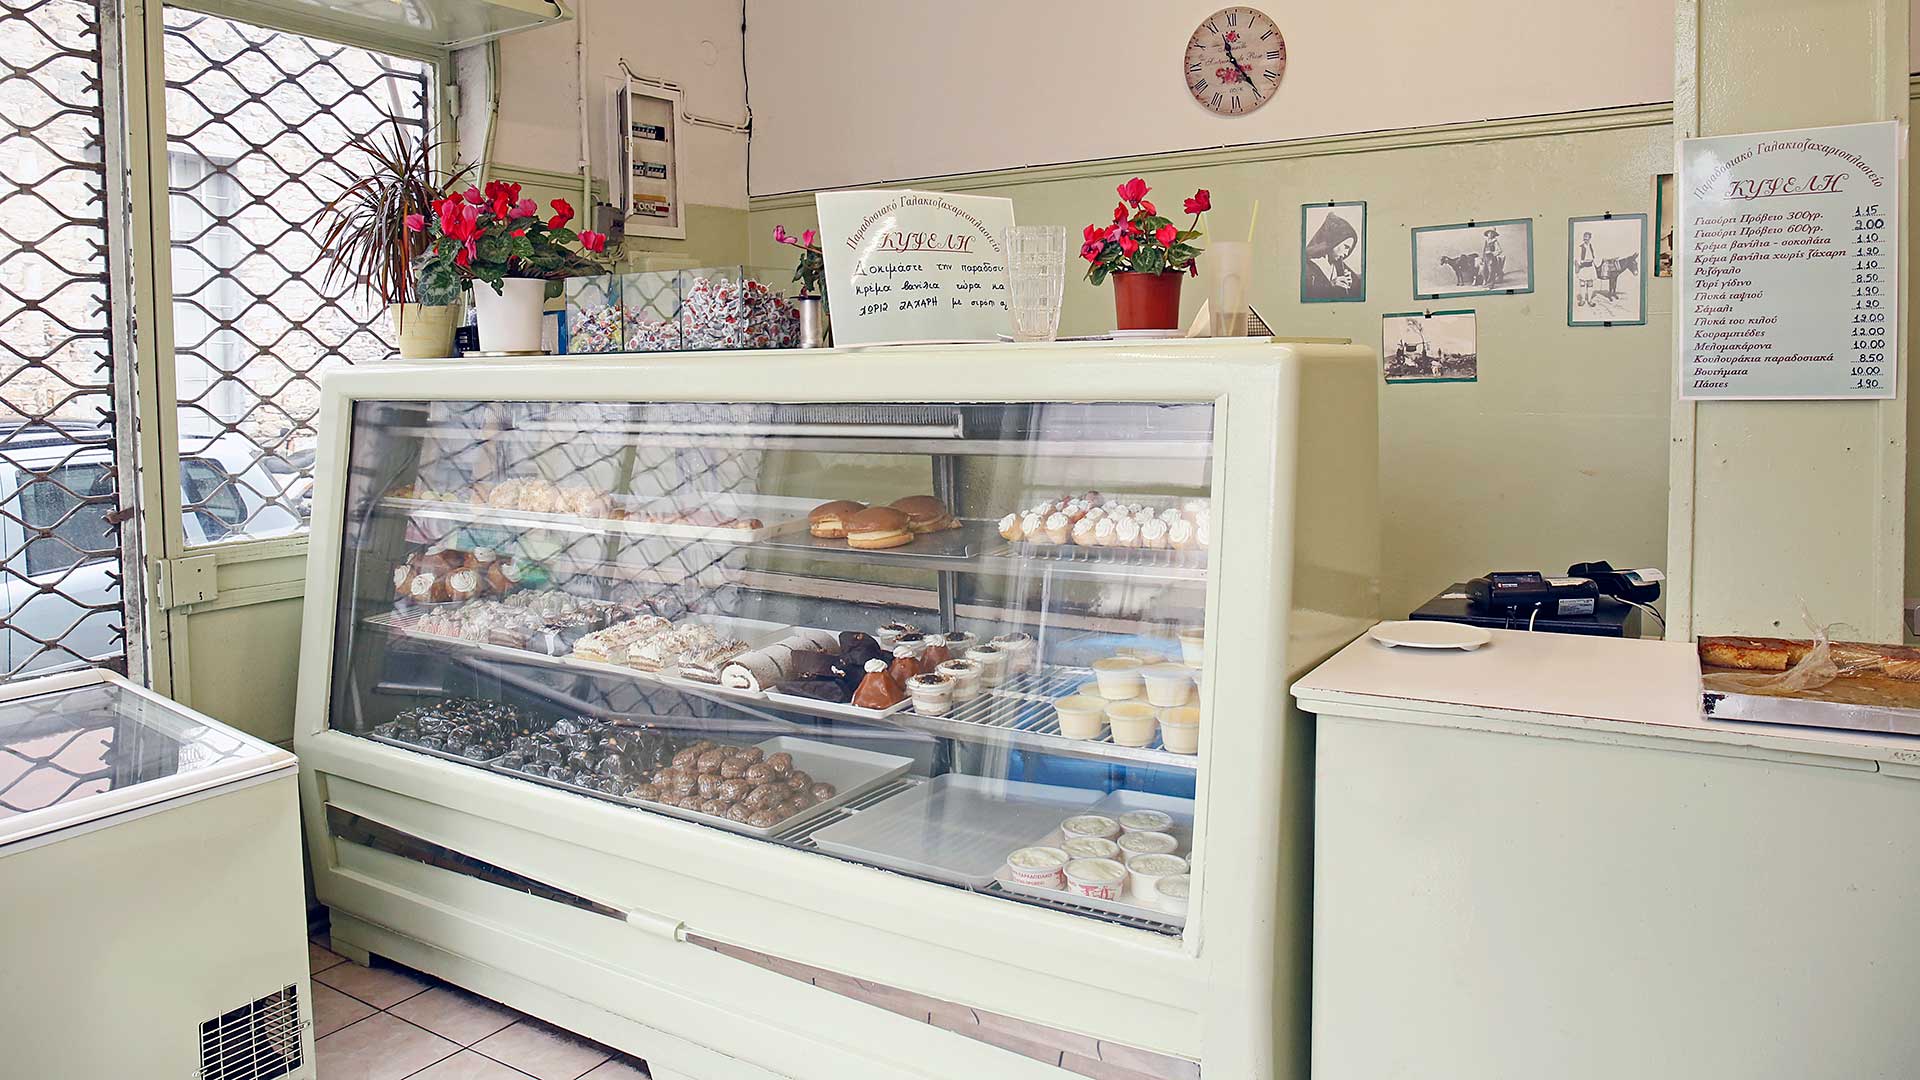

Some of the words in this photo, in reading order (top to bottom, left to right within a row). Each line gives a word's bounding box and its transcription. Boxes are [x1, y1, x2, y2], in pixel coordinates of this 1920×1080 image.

[1694, 147, 1753, 200] Παραδοσιακό
[1724, 173, 1850, 200] ΚΥΨΕΛΗ
[1694, 217, 1737, 226] Γιαούρτι
[1740, 213, 1783, 225] Πρόβειο
[1787, 210, 1824, 221] 300γρ.
[1855, 204, 1879, 217] 1.15
[846, 199, 898, 250] Παραδοσιακό
[1694, 229, 1737, 239] Γιαούρτι
[1740, 226, 1783, 238] Πρόβειο
[1787, 223, 1824, 235] 600γρ.
[1854, 218, 1885, 231] 2.00
[878, 231, 976, 253] ΚΥΨΕΛΗ
[1694, 241, 1728, 252] Κρέμα
[1729, 240, 1770, 251] βανίλια
[1781, 236, 1832, 246] σοκολάτα
[1856, 232, 1879, 244] 1.10
[1694, 254, 1728, 265] Κρέμα
[1729, 252, 1770, 264] βανίλια
[1772, 250, 1804, 261] χωρίς
[1806, 248, 1847, 260] ζάχαρη
[854, 260, 923, 280] Δοκιμάστε
[1694, 266, 1742, 277] Ρυζόγαλο
[856, 282, 893, 297] κρέμα
[956, 280, 982, 293] τώρα
[1695, 279, 1719, 289] Τυρί
[1721, 279, 1752, 289] γίδινο
[1856, 273, 1879, 284] 8.50
[1694, 291, 1726, 301] Γλυκά
[1729, 290, 1764, 302] ταψιού
[1694, 304, 1733, 315] Σάμαλι
[1694, 317, 1726, 326] Γλυκά
[1748, 315, 1778, 325] κιλού
[1694, 329, 1766, 341] Κουραμπιέδες
[1694, 342, 1773, 353] Μελομακάρονα
[1694, 354, 1762, 365] Κουλουράκια
[1764, 352, 1834, 364] παραδοσιακά
[1859, 353, 1885, 363] 8.50
[1694, 367, 1749, 378] Βουτήματα
[1693, 379, 1729, 389] Πάστες
